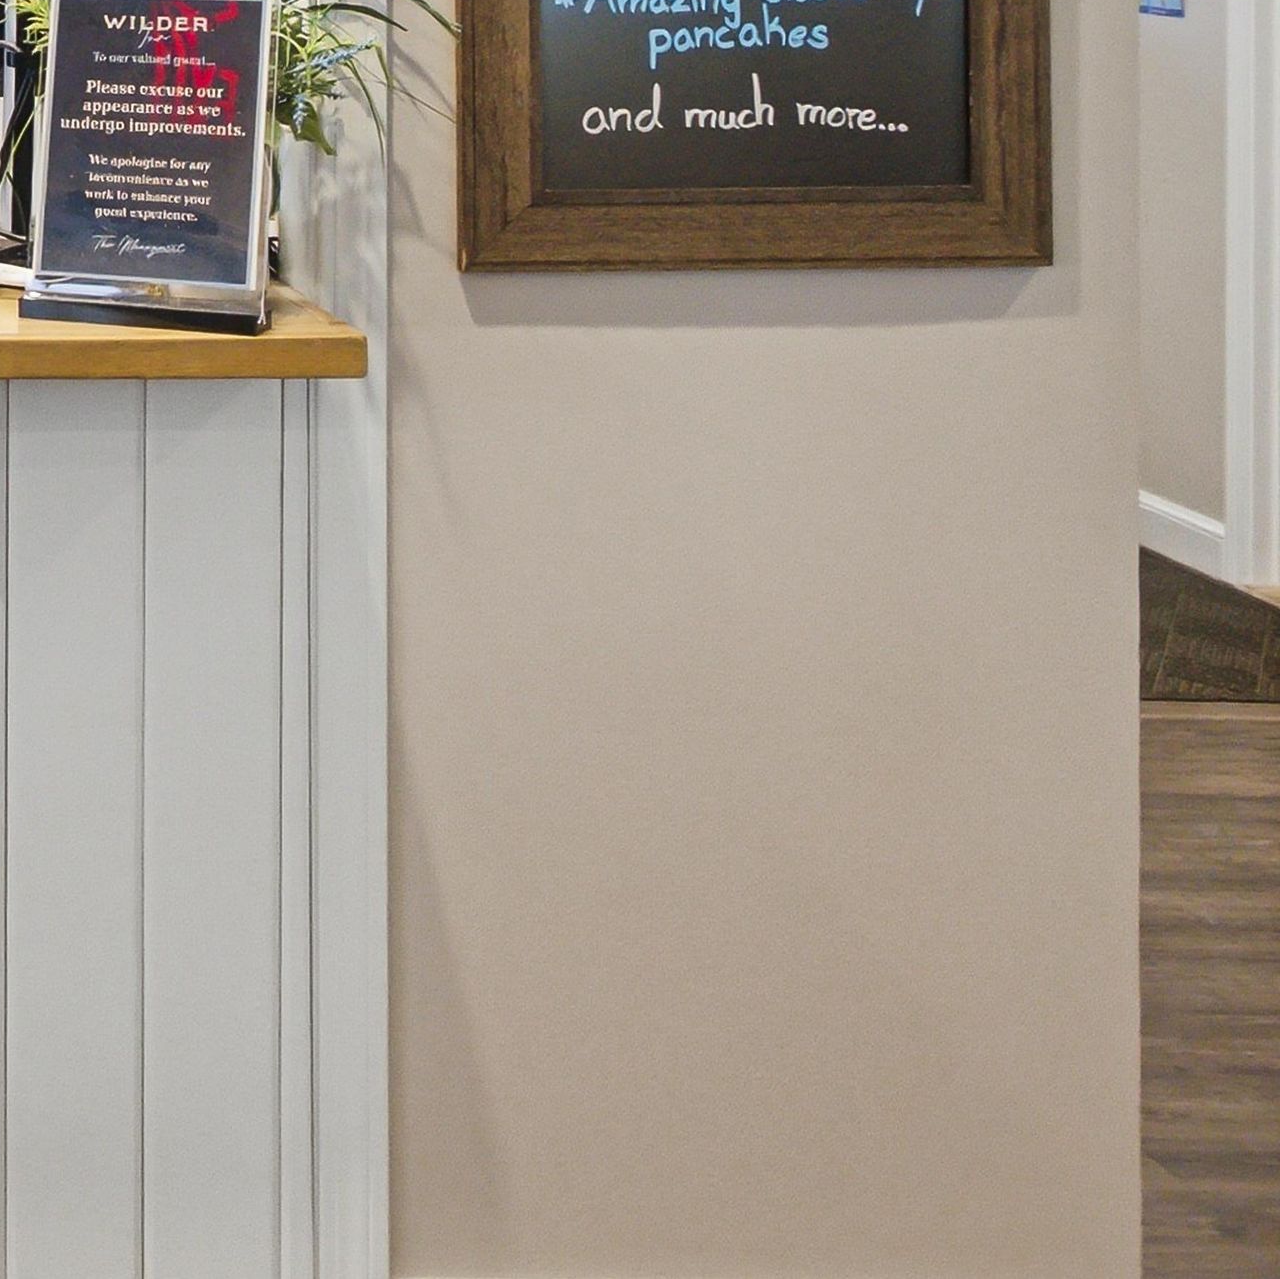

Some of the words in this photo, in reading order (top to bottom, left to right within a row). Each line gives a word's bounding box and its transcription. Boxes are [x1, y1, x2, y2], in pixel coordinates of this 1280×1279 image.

[103, 14, 208, 32] WILDER
[648, 3, 830, 69] pancakes
[92, 51, 107, 63] To
[109, 54, 129, 64] our
[131, 53, 171, 65] valued
[85, 79, 136, 95] Please
[139, 85, 193, 98] excuse
[196, 87, 224, 99] our
[82, 101, 173, 116] appearance
[176, 104, 195, 116] as
[197, 106, 222, 117] we
[582, 82, 663, 135] and
[684, 73, 774, 129] much
[60, 116, 125, 134] undergo
[128, 118, 246, 137] improvements.
[88, 153, 108, 166] We
[110, 156, 168, 170] apologize
[169, 158, 187, 169] for
[189, 161, 212, 174] any
[88, 172, 174, 186] inconvenience
[175, 177, 189, 187] as
[191, 178, 209, 188] we
[84, 189, 114, 200] work
[116, 189, 128, 200] to
[130, 190, 181, 204] enhance
[184, 194, 212, 206] your
[94, 207, 127, 219] guest
